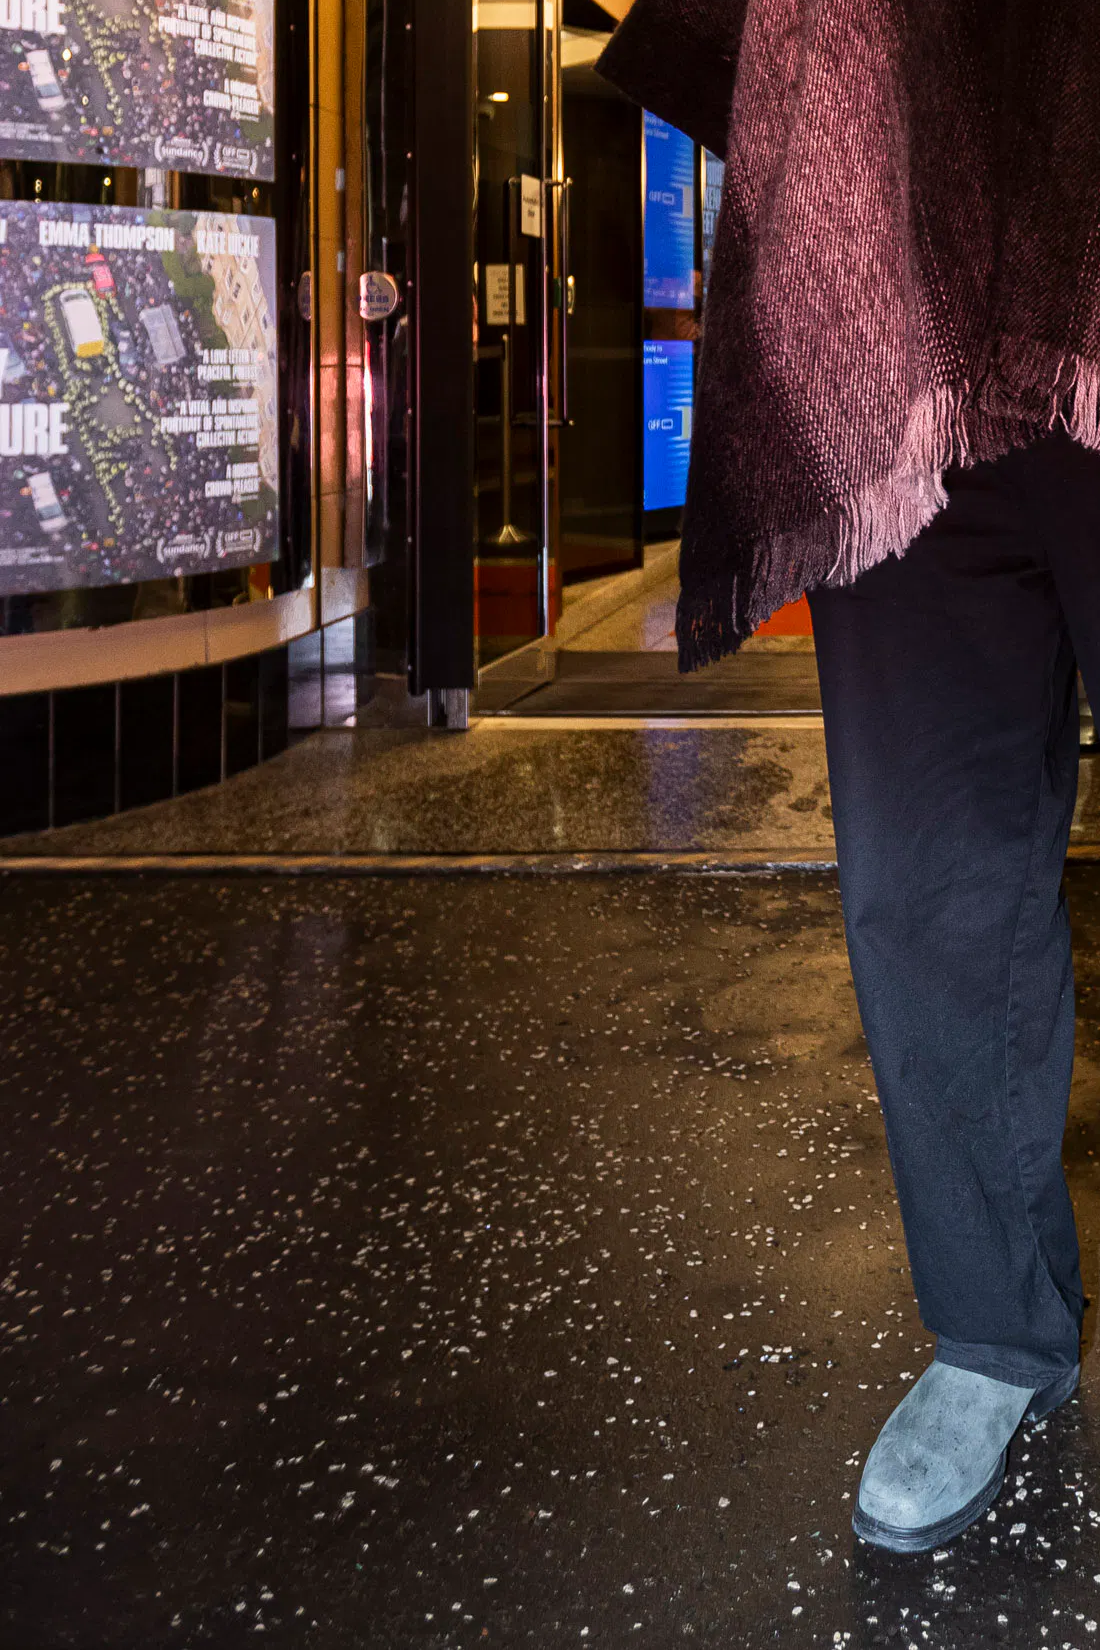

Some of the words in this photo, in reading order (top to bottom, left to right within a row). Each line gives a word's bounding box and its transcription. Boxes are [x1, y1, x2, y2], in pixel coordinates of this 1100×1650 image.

[39, 221, 90, 247] EMMA
[94, 223, 175, 251] THOMPSON
[211, 399, 227, 415] AND
